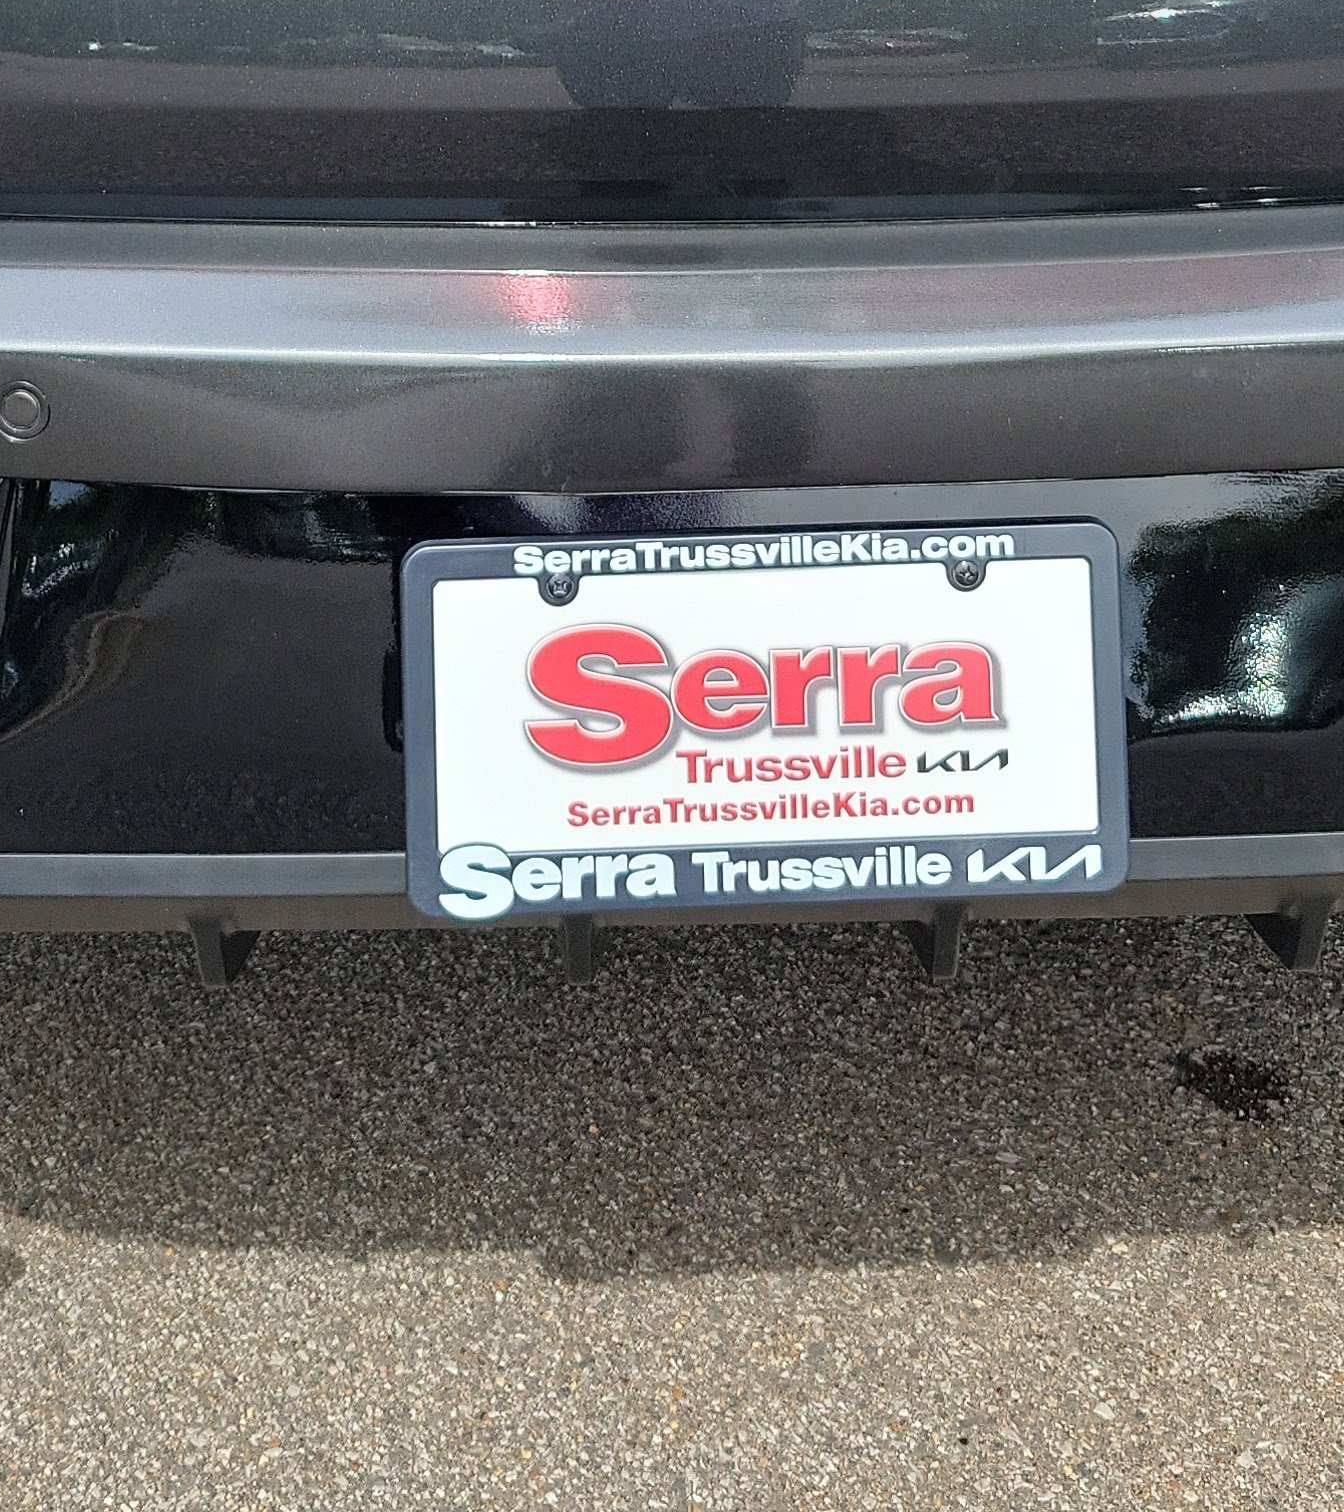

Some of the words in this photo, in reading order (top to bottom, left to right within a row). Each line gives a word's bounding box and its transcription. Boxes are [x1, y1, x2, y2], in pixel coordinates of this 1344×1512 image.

[512, 533, 1015, 576] SerraTrussvilleKia.com
[524, 623, 1005, 767] Serra
[676, 745, 907, 784] Trussville
[916, 747, 1009, 774] KIA
[567, 791, 975, 827] SerraTrussvilleKia.com
[437, 842, 677, 920] Serra
[692, 845, 952, 892] Trussville
[966, 844, 1103, 884] KIA
